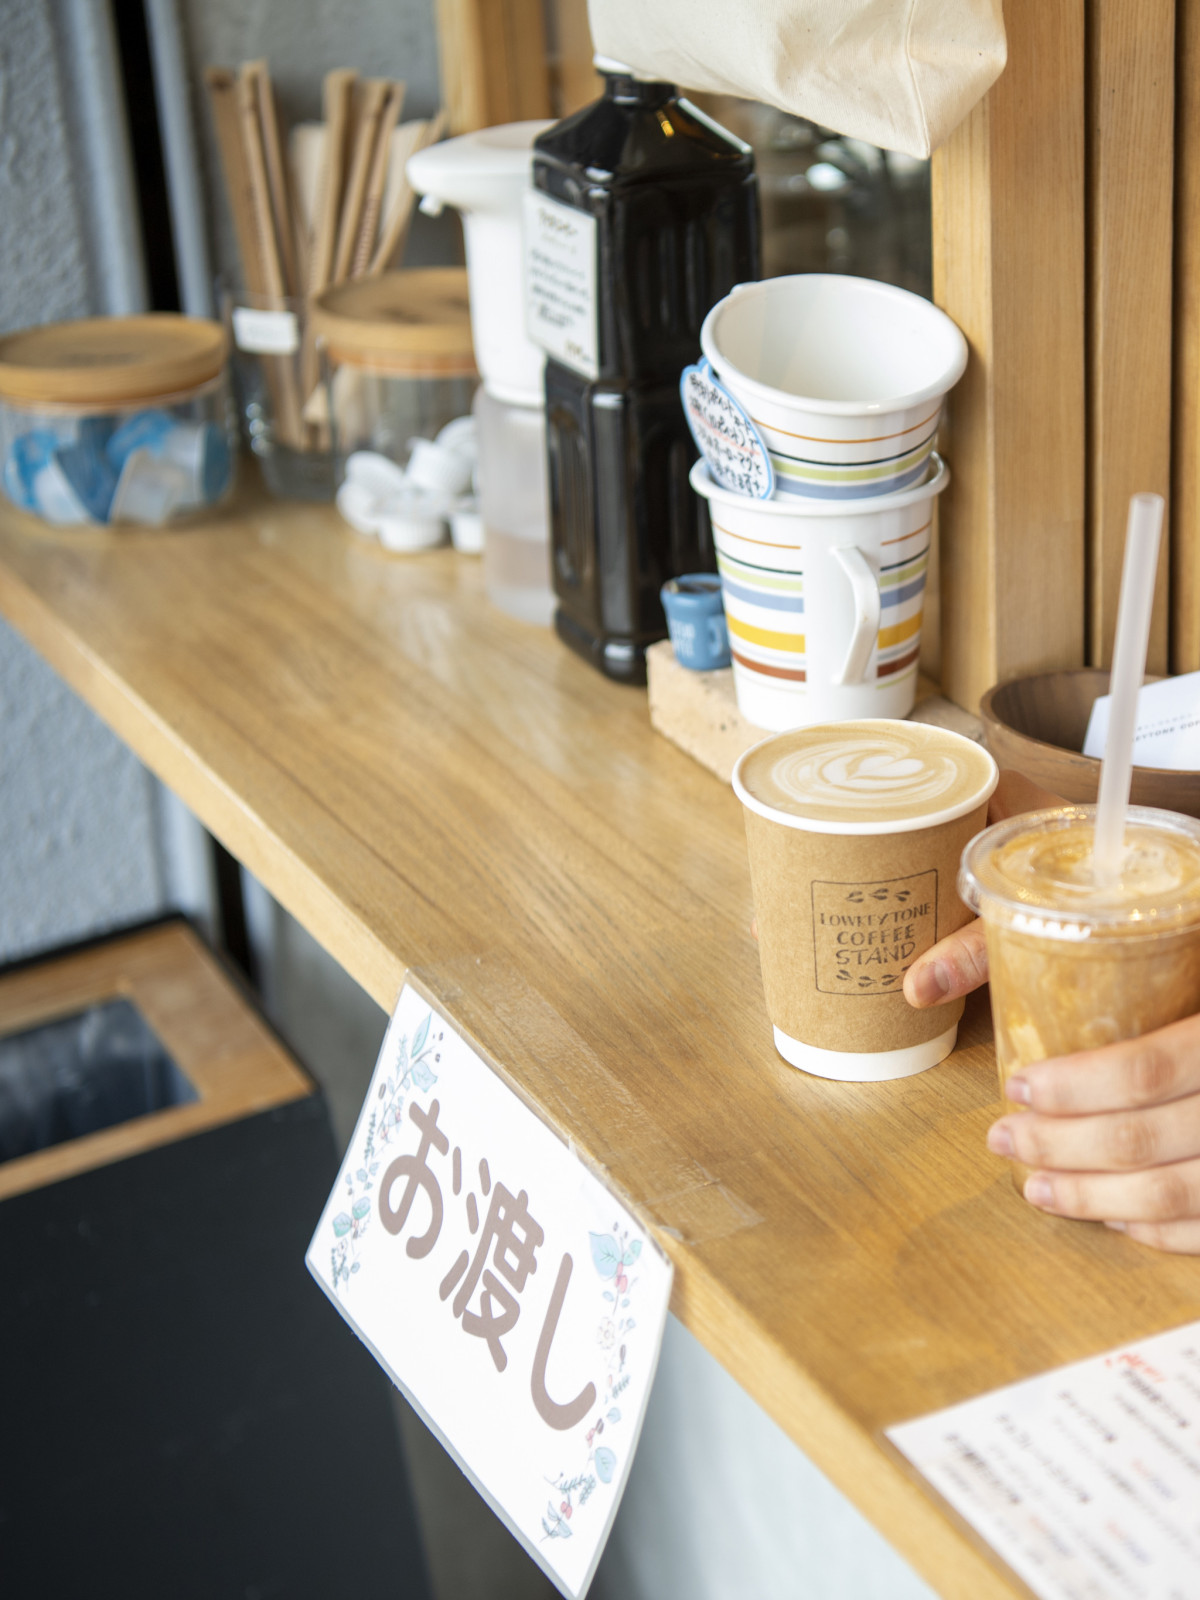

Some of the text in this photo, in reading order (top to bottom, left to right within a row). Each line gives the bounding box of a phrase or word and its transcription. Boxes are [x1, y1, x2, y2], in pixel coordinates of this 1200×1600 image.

[820, 902, 932, 928] LOWKEYTONE
[836, 923, 916, 946] COFFEE
[835, 941, 917, 966] STAND
[377, 1097, 598, 1432] お渡し
